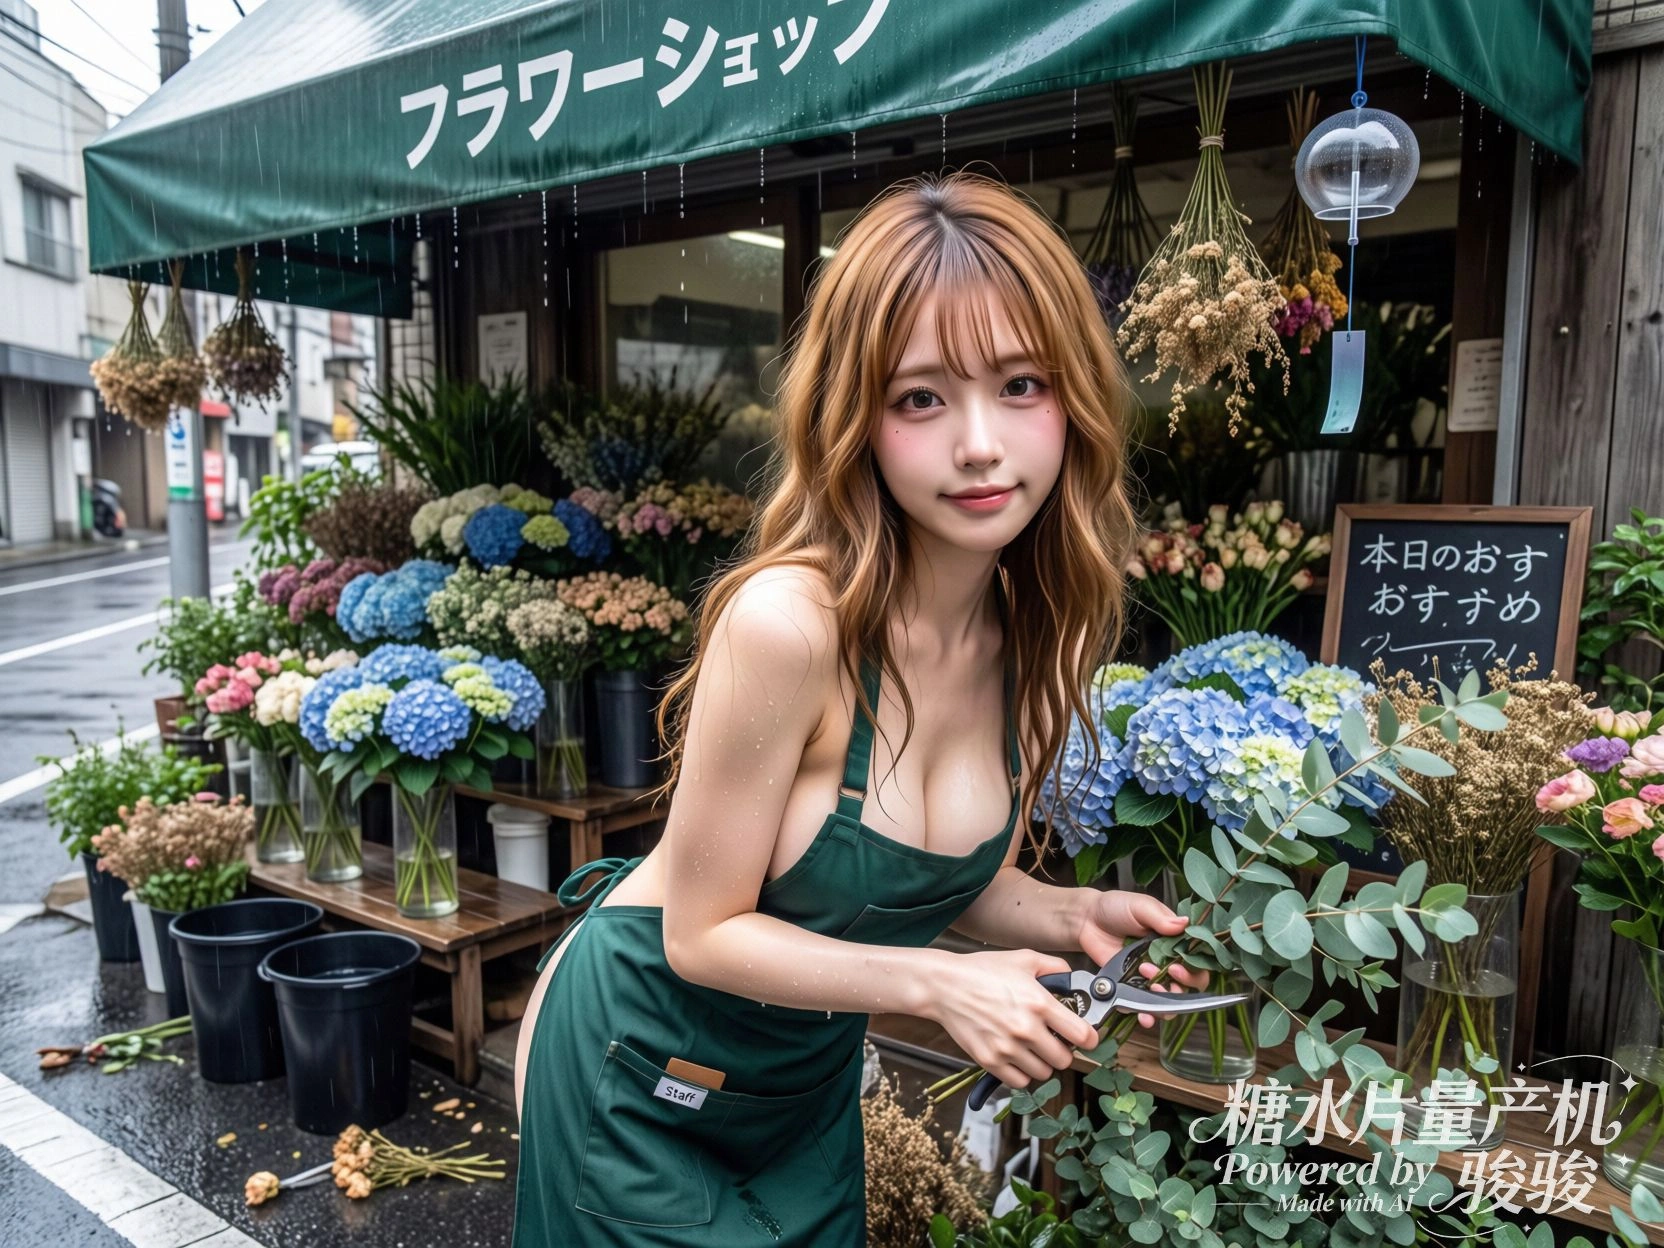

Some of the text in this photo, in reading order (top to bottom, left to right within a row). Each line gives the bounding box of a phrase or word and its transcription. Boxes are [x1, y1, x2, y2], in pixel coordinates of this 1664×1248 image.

[1360, 533, 1549, 583] 本日のおす
[665, 1086, 696, 1103] Staff
